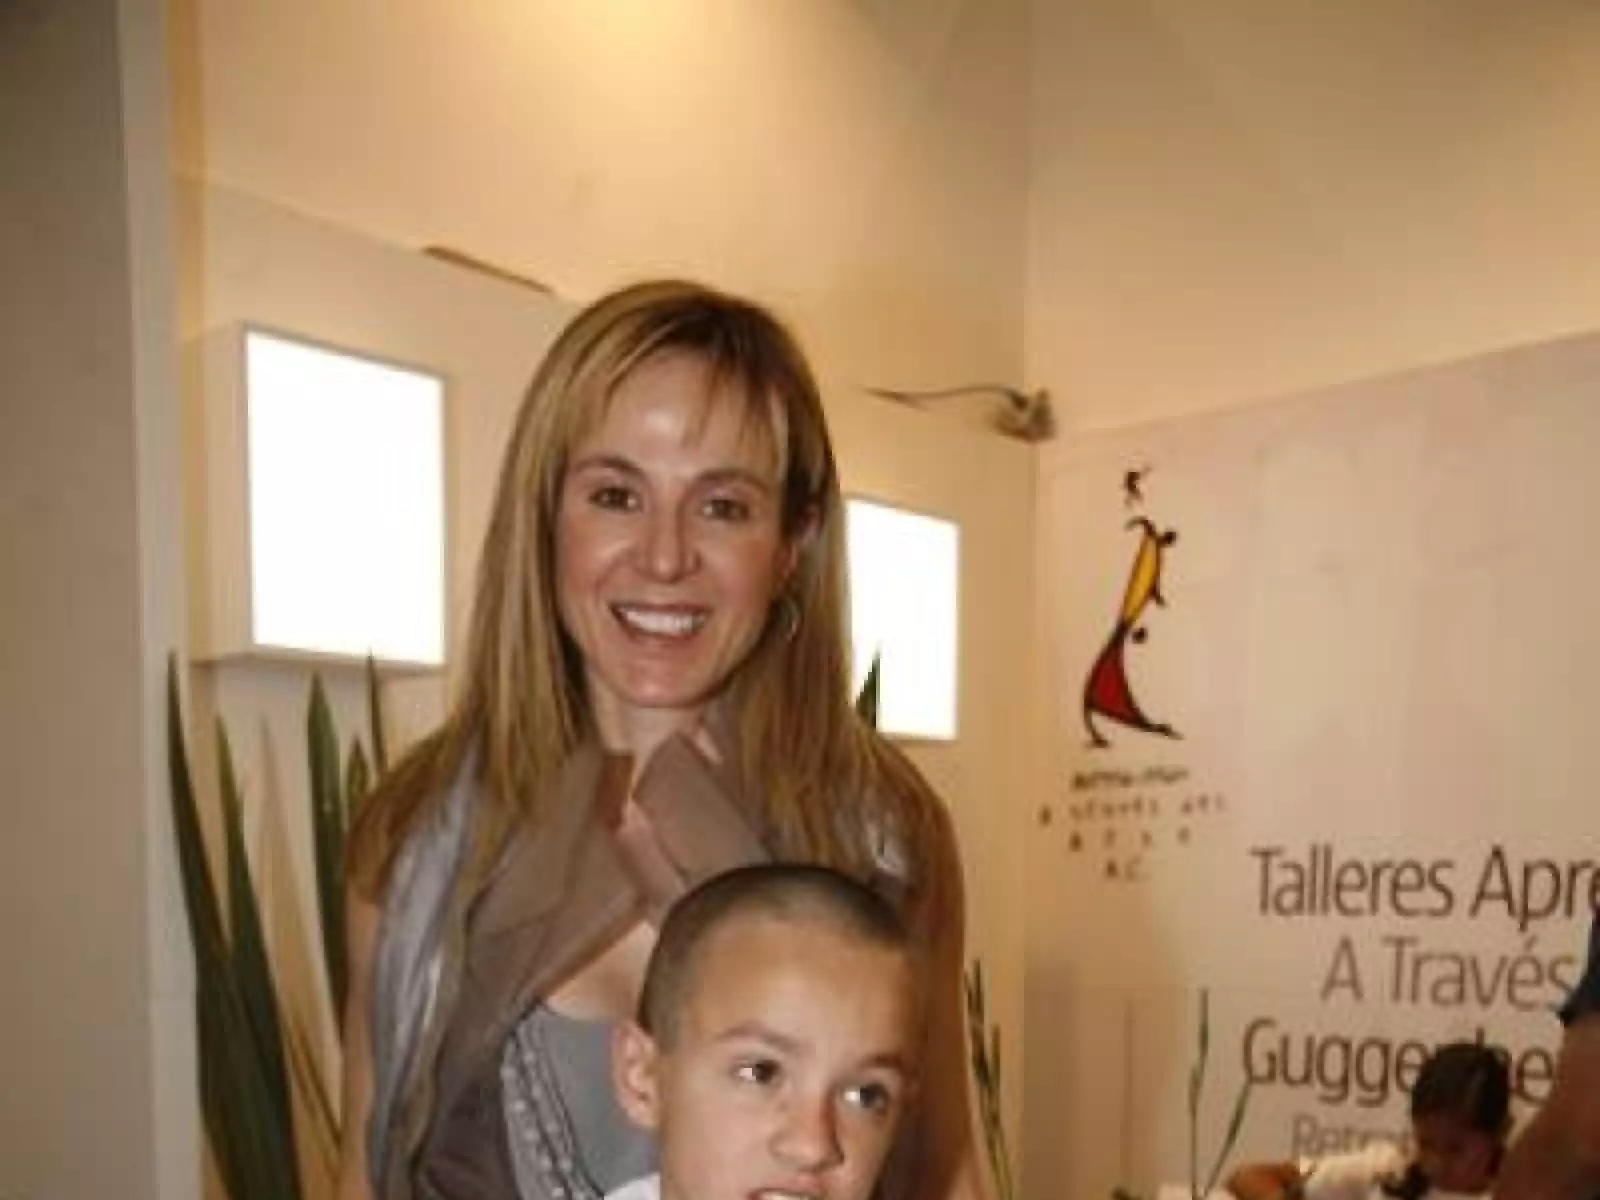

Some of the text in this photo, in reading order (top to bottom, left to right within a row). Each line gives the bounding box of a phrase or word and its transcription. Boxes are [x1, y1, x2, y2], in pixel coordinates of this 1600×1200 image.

[1251, 844, 1454, 917] Talleres
[1320, 935, 1577, 1011] A Través
